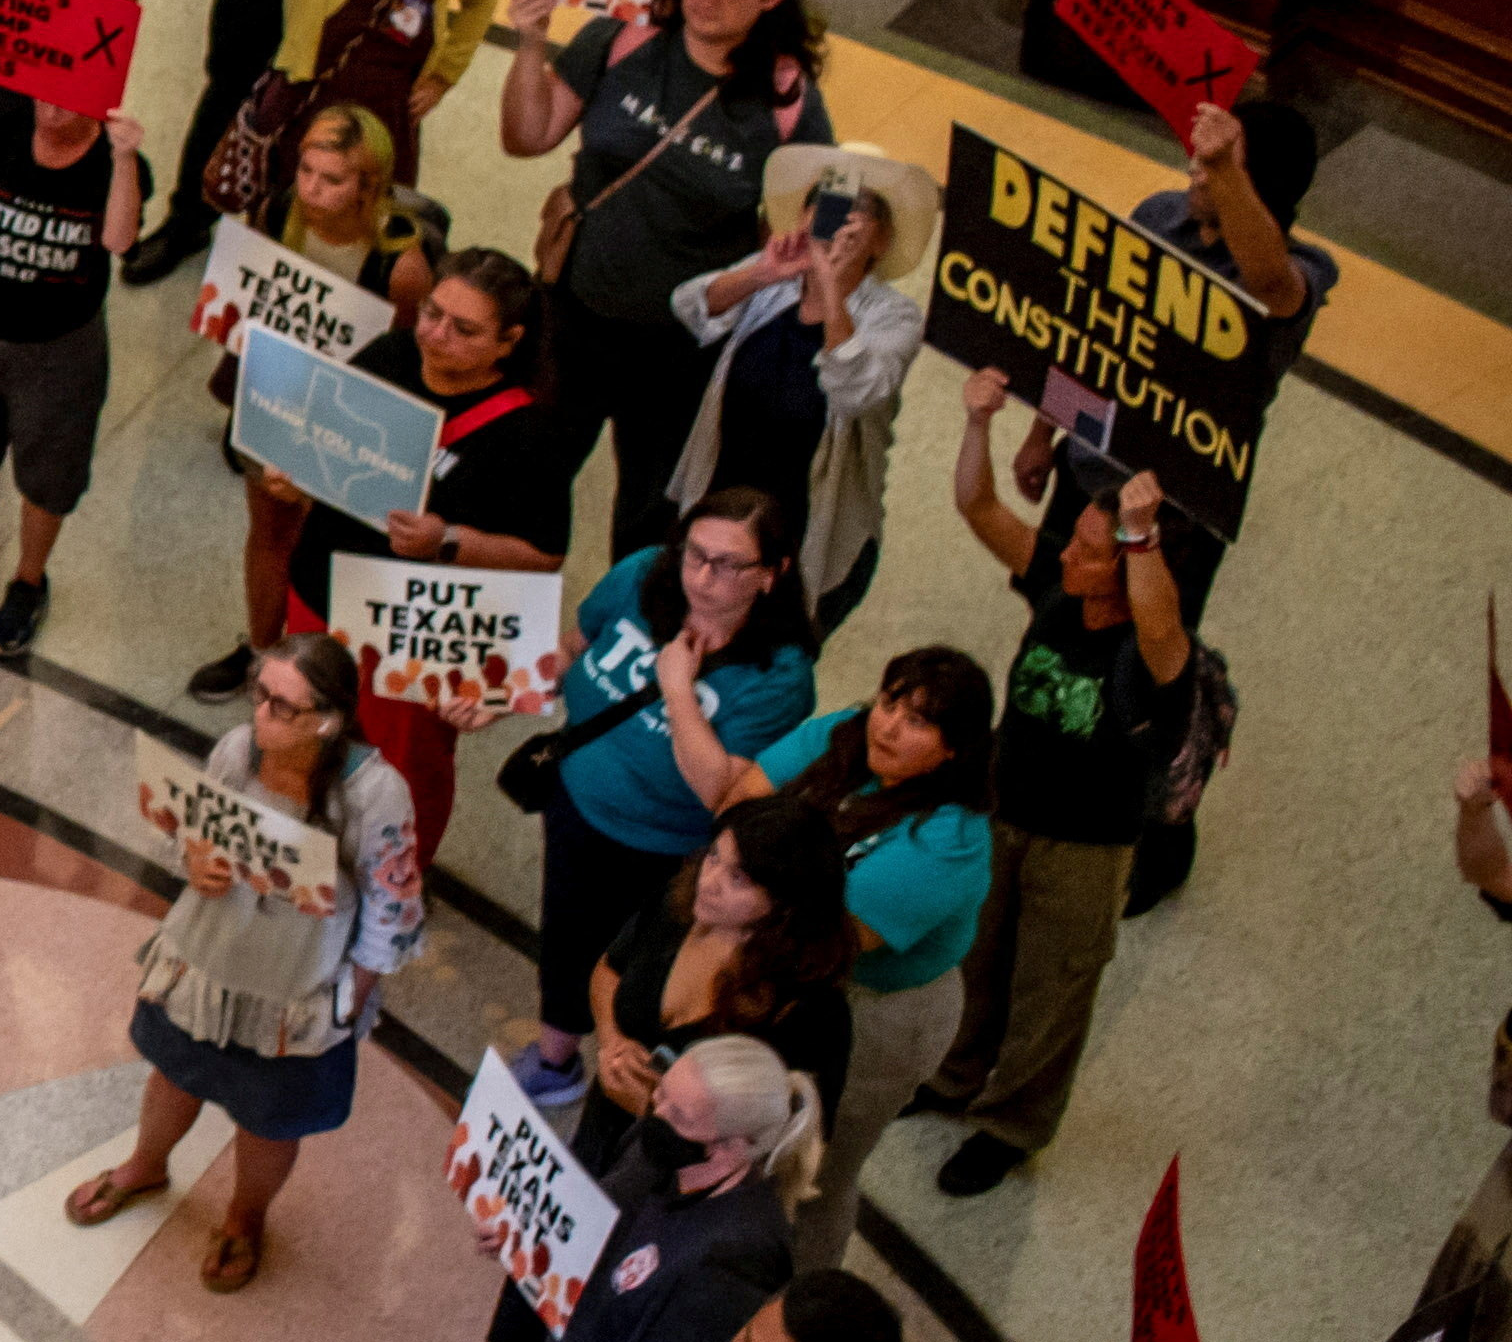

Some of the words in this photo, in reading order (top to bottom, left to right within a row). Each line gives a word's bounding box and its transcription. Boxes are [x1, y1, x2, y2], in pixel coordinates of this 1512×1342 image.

[273, 260, 333, 304] PUT
[988, 148, 1248, 360] DEFEND
[239, 266, 355, 347] TEXANS
[1058, 267, 1158, 369] THE
[938, 251, 1249, 482] CONSTITUTION
[365, 601, 520, 639] TEXANS
[405, 578, 482, 609] PUT
[389, 631, 492, 661] FIRST
[487, 1113, 576, 1243] TEXANS
[516, 1117, 563, 1183] PUT
[486, 1160, 552, 1245] FIRST
